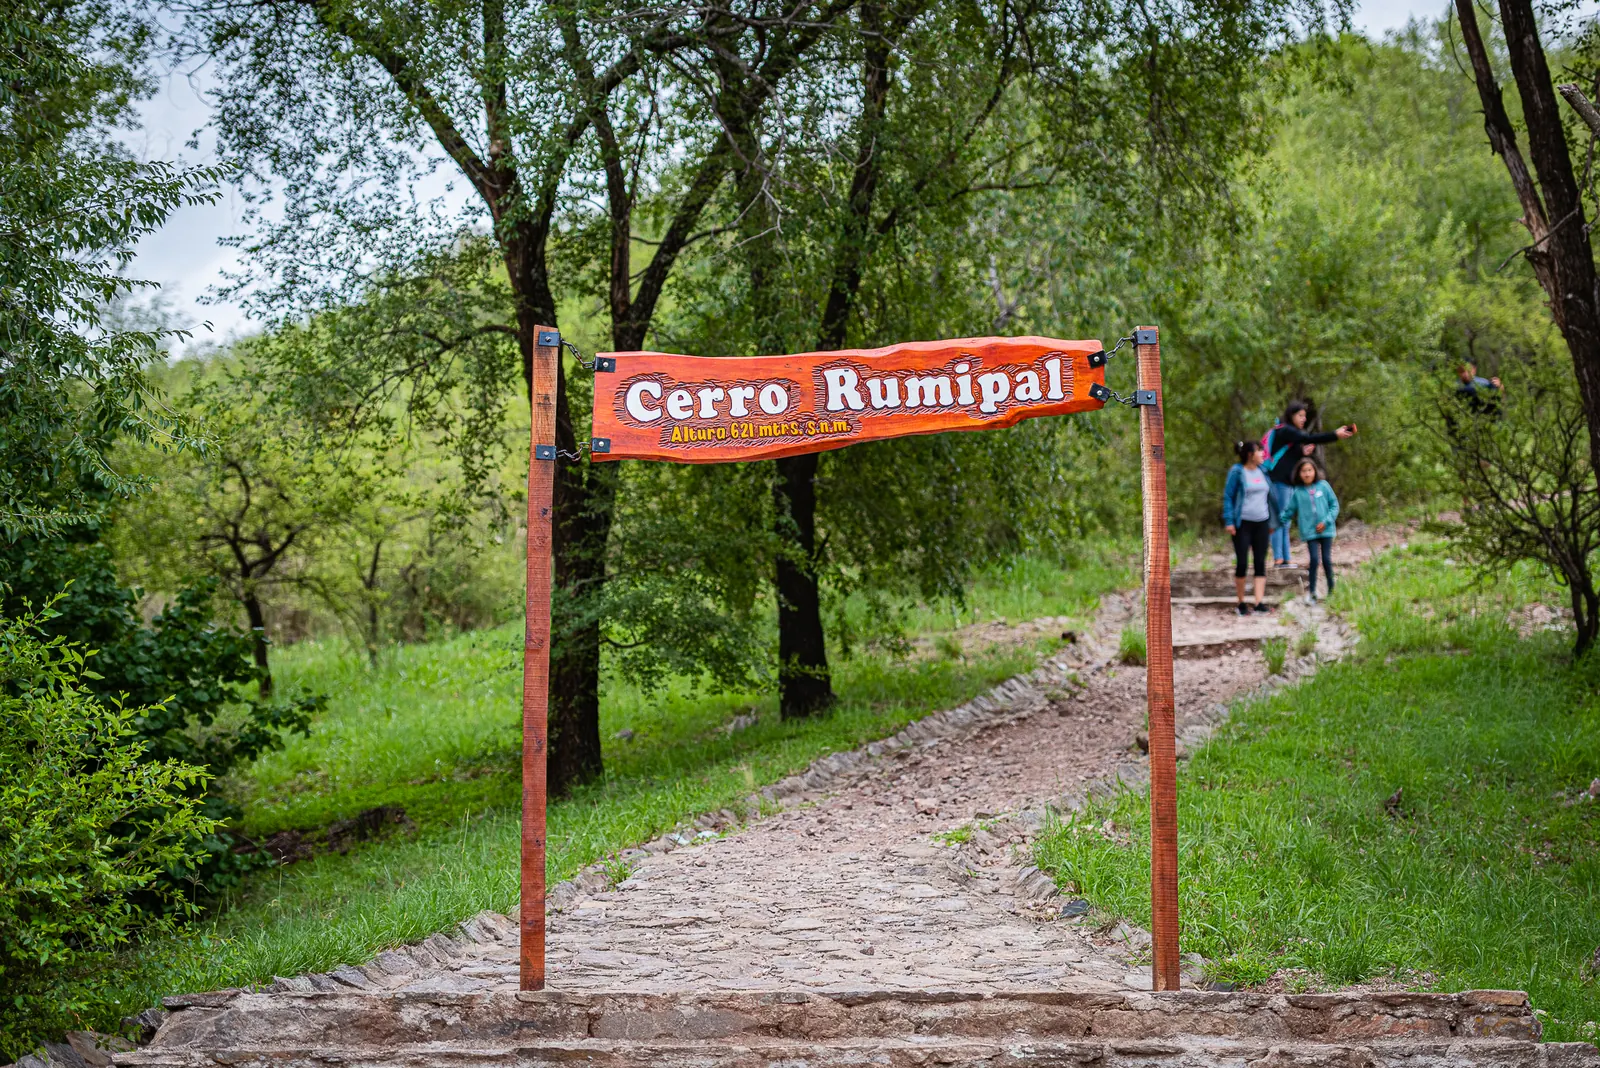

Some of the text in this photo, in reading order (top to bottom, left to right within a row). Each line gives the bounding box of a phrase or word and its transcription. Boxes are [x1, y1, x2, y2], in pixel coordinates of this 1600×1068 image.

[625, 358, 1064, 422] Cerro Rumipal
[671, 426, 726, 443] Altura
[730, 422, 754, 439] 621
[759, 421, 803, 437] mtrs.
